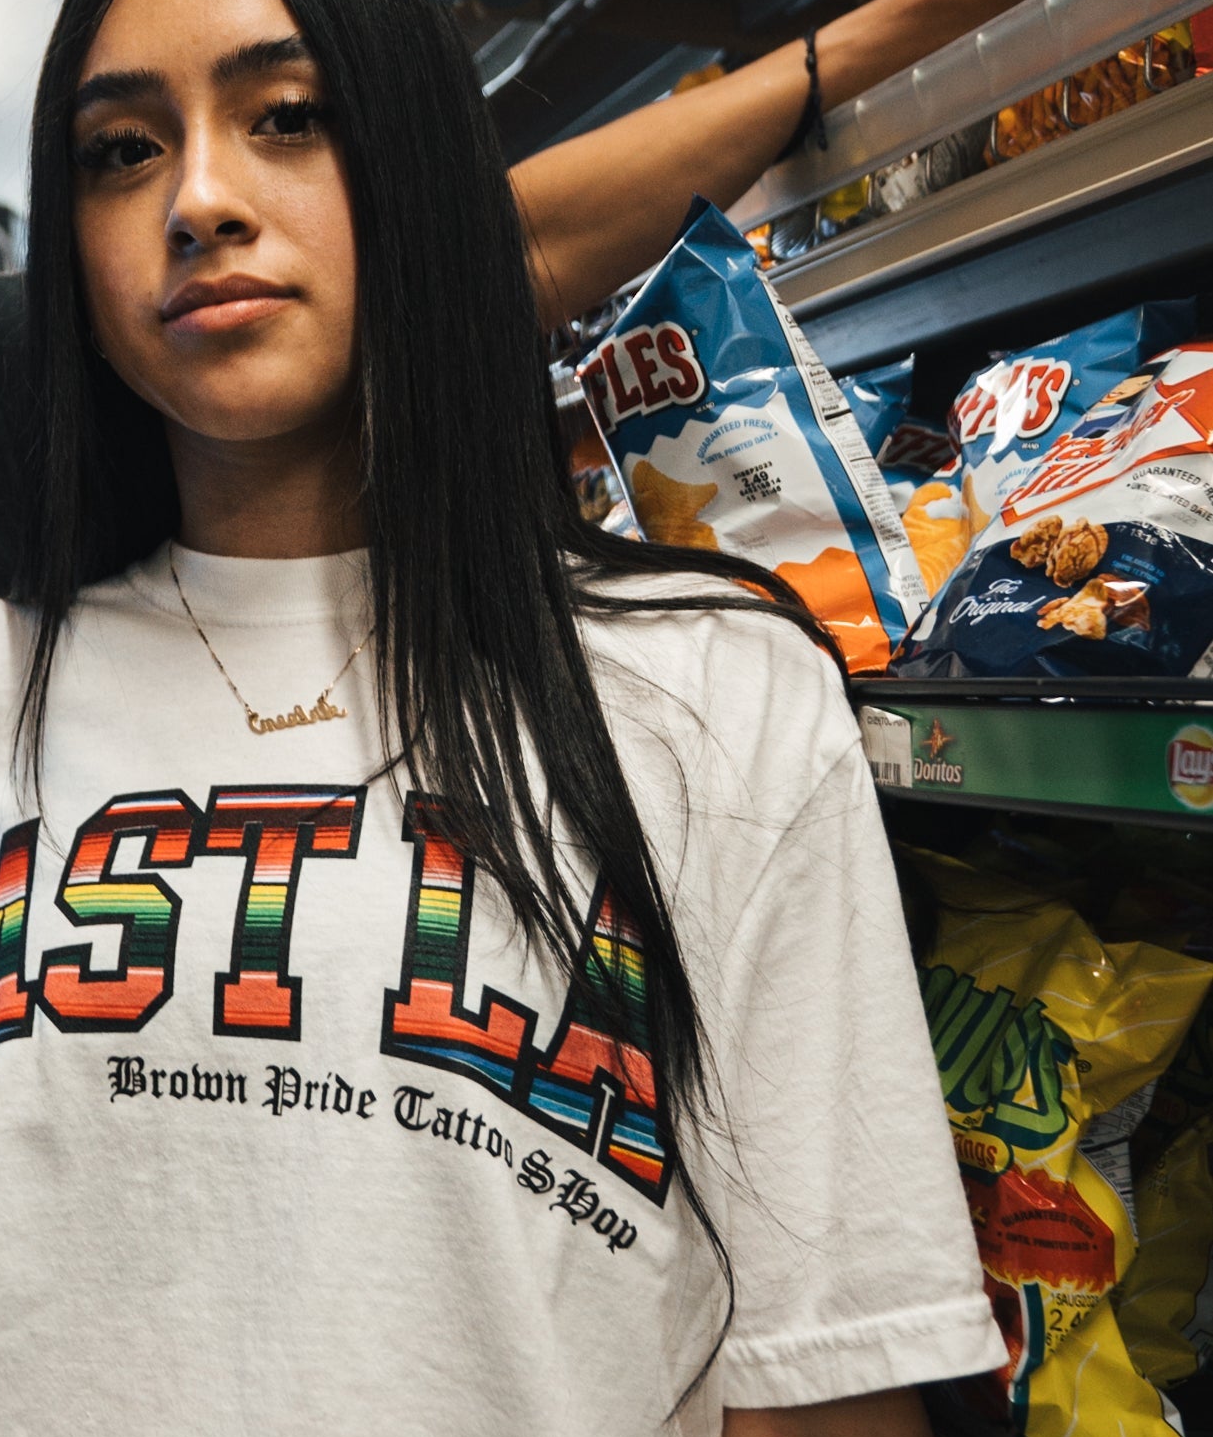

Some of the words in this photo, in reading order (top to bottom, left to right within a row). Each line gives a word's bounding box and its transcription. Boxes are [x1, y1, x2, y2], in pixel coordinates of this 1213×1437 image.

[696, 420, 741, 458] GUARANTEED
[743, 418, 774, 430] FRESH
[724, 438, 754, 457] PRINTED
[755, 432, 773, 445] DATE
[741, 470, 769, 488] 2.49
[1132, 466, 1202, 486] GUARANTEED
[982, 578, 1023, 599] The
[948, 595, 1047, 626] Original
[913, 757, 963, 785] Doritos
[379, 789, 680, 1209] LA
[106, 1055, 249, 1105] Brown
[261, 1063, 376, 1121] Pride
[393, 1084, 515, 1169] Tattoo
